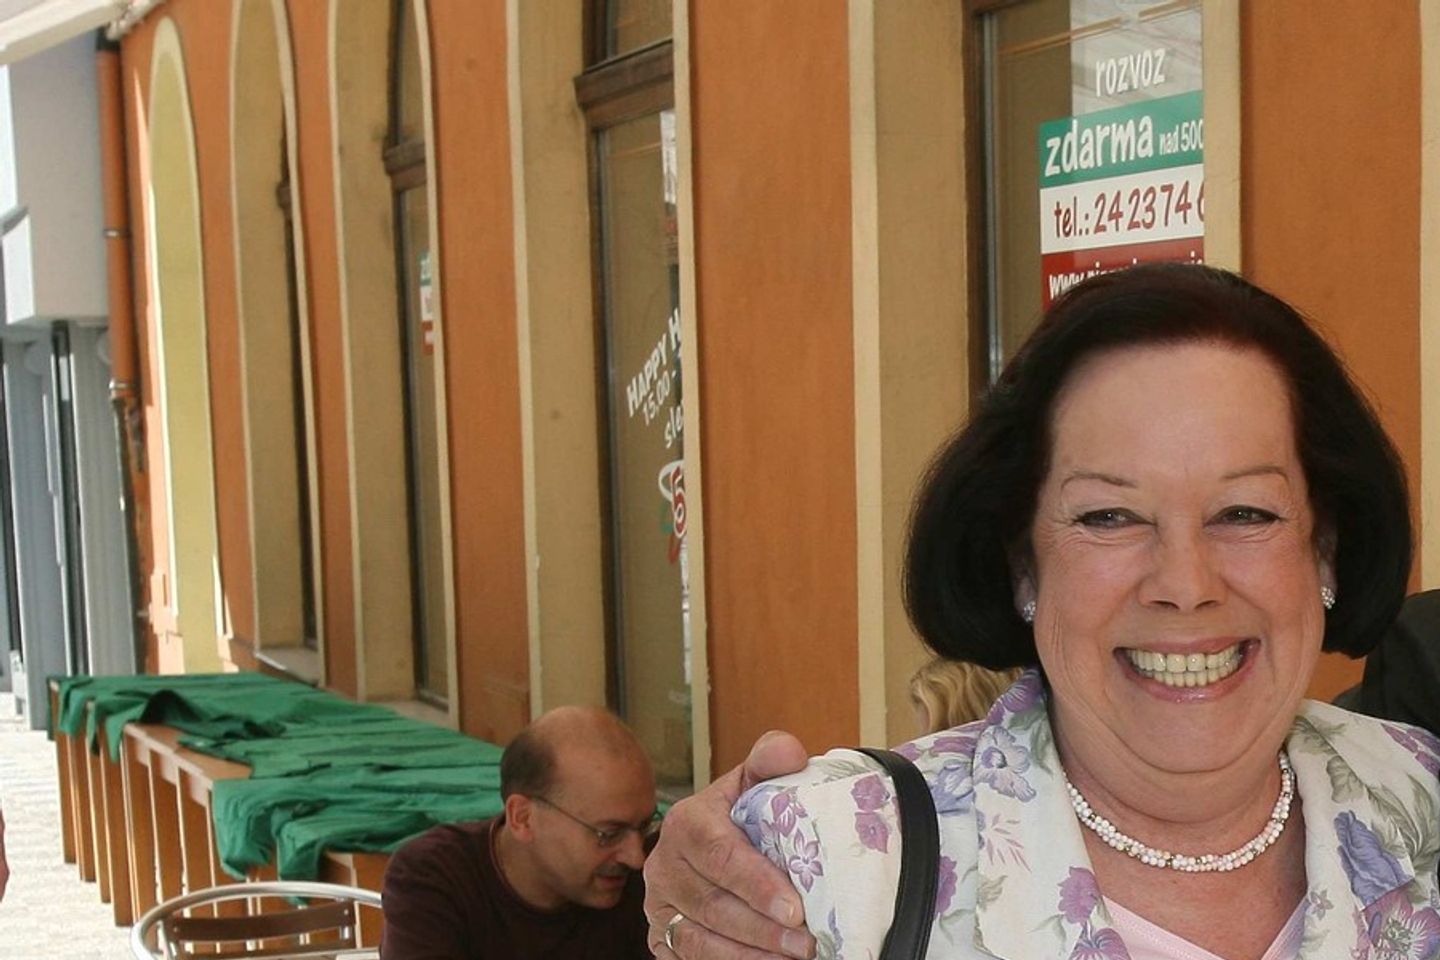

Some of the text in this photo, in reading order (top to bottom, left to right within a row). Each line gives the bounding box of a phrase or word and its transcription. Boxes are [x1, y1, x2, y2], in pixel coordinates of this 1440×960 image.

[1096, 48, 1165, 97] rozvoz
[1044, 115, 1153, 177] zdarma
[1158, 124, 1179, 155] nad
[626, 333, 667, 418] HAPPY
